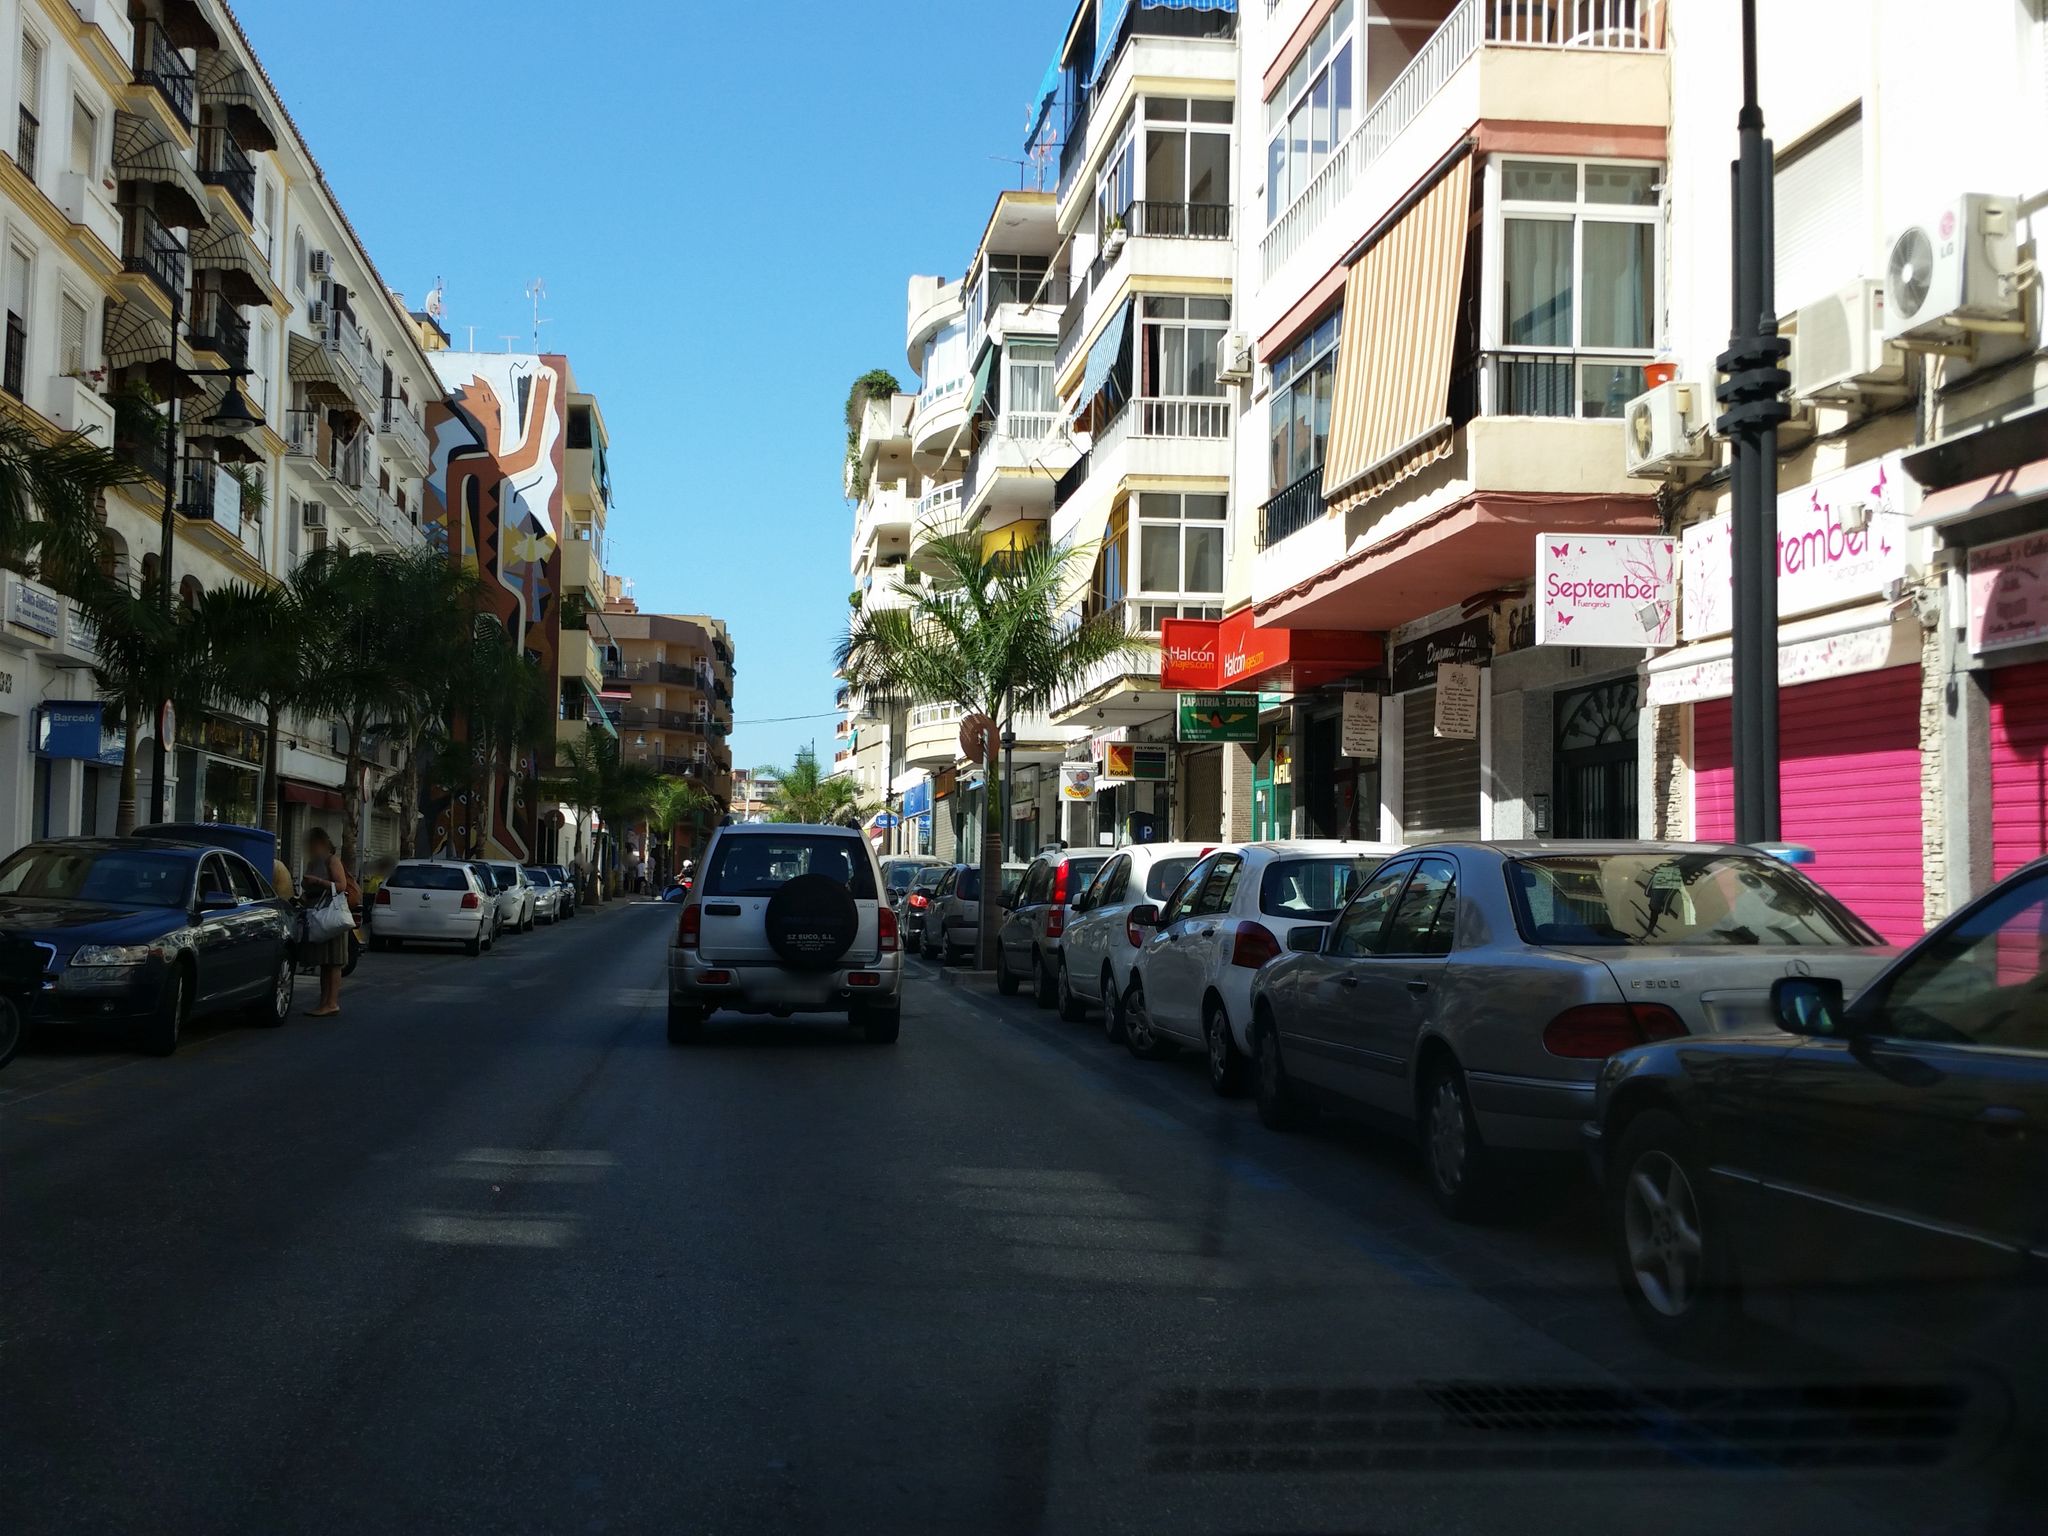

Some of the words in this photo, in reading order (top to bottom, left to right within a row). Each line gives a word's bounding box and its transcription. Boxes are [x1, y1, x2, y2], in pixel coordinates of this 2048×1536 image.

[1940, 242, 1954, 258] LG
[1547, 573, 1660, 606] September
[1182, 697, 1219, 708] ZAPATERIA
[1226, 697, 1256, 708] EXPRESS
[53, 713, 95, 722] Barceló
[1110, 769, 1132, 777] Kodak
[1144, 826, 1153, 839] P
